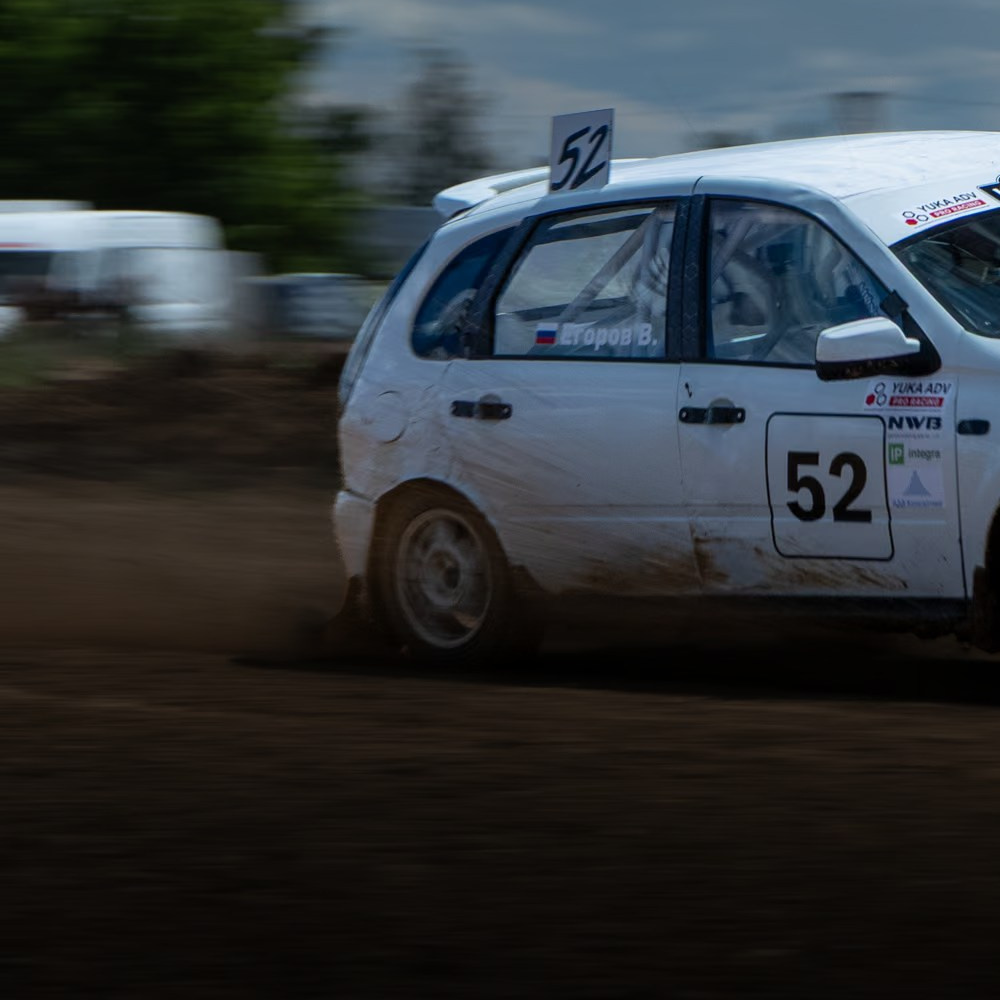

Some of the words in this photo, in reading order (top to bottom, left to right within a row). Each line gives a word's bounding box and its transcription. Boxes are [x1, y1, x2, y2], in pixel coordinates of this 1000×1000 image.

[551, 124, 608, 190] 52
[916, 198, 954, 213] YUKA
[952, 191, 977, 204] ADV
[560, 322, 633, 352] Егоров
[638, 322, 658, 346] В.
[892, 382, 924, 394] YUKA
[925, 382, 952, 395] ADV
[888, 415, 943, 430] NWB
[786, 451, 872, 523] 52
